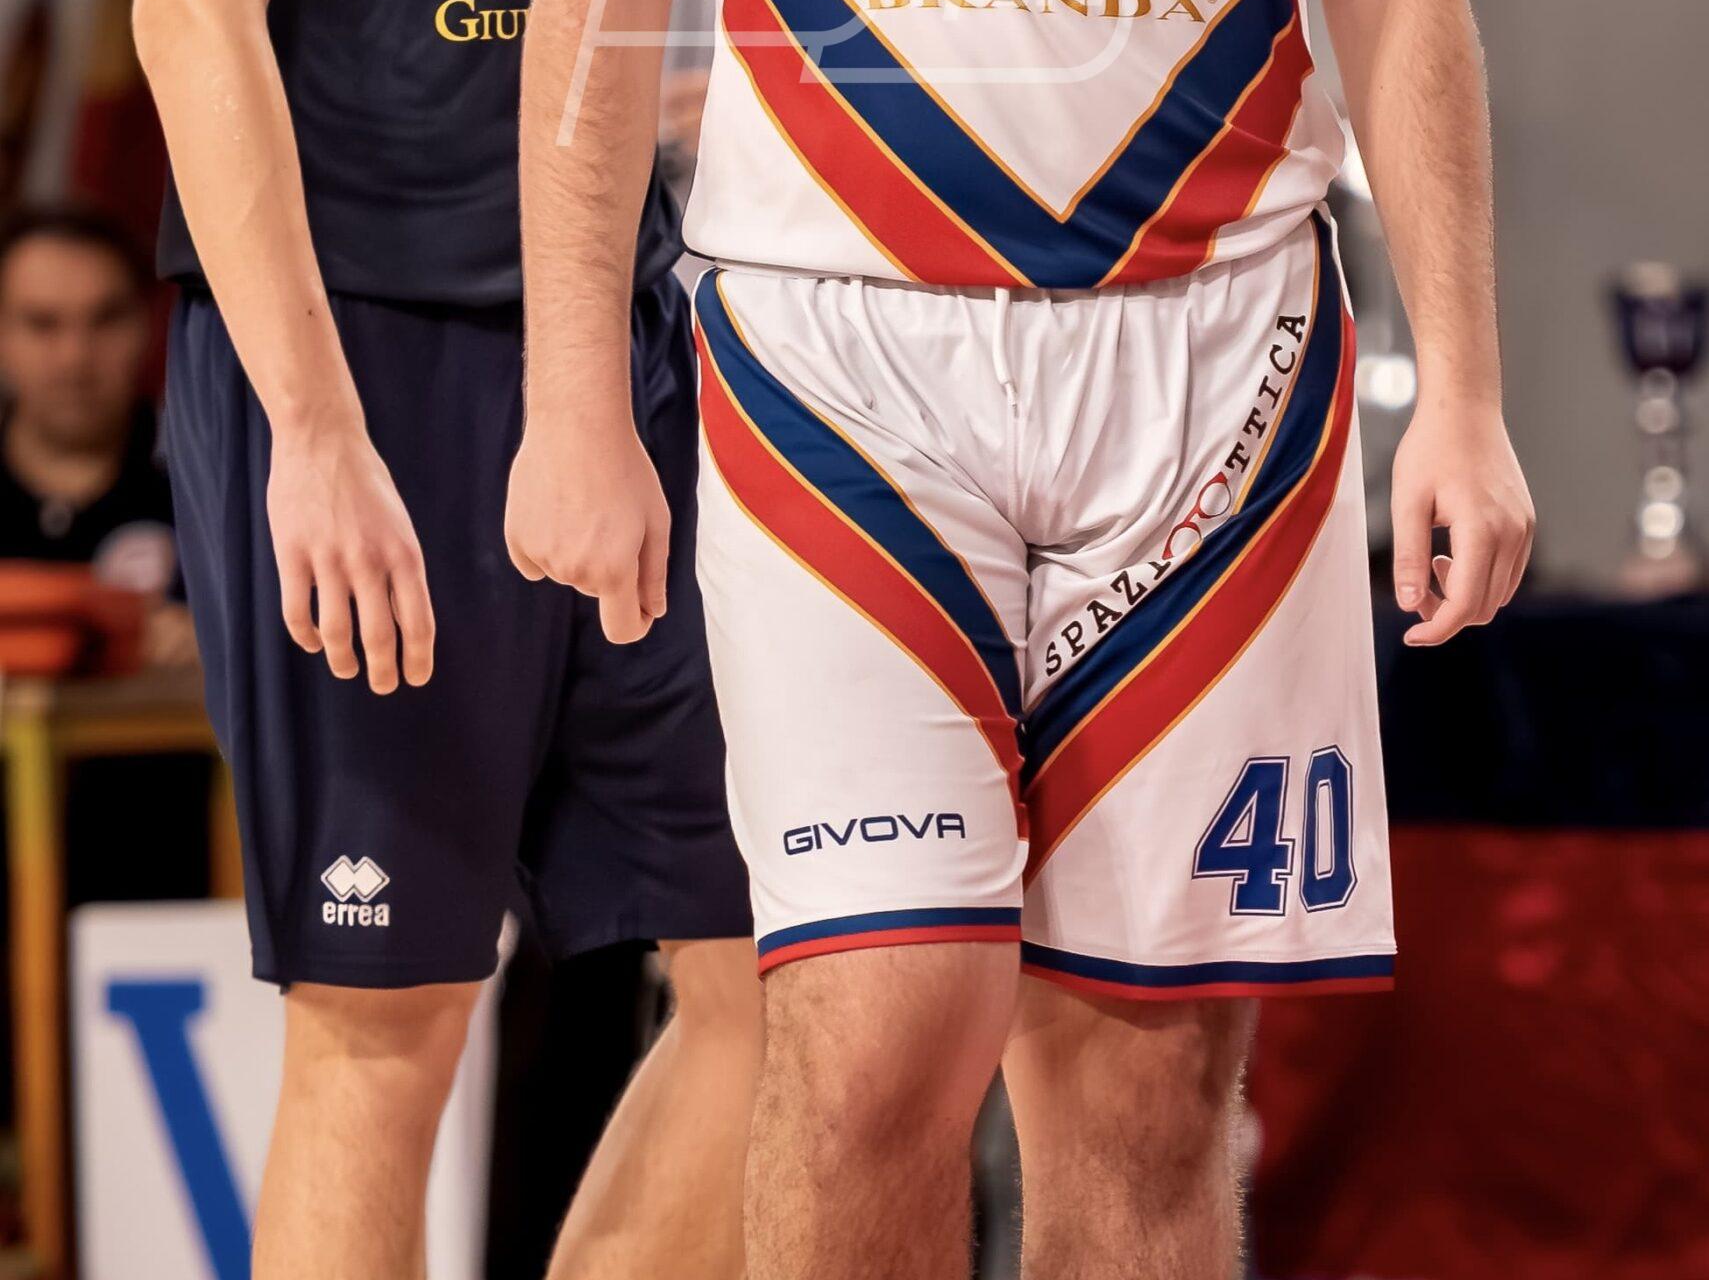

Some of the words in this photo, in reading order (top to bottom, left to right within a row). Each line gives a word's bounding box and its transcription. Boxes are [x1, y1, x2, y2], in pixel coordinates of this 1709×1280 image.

[783, 812, 966, 856] GIVOVA
[1191, 744, 1358, 917] 40
[322, 901, 390, 927] errea
